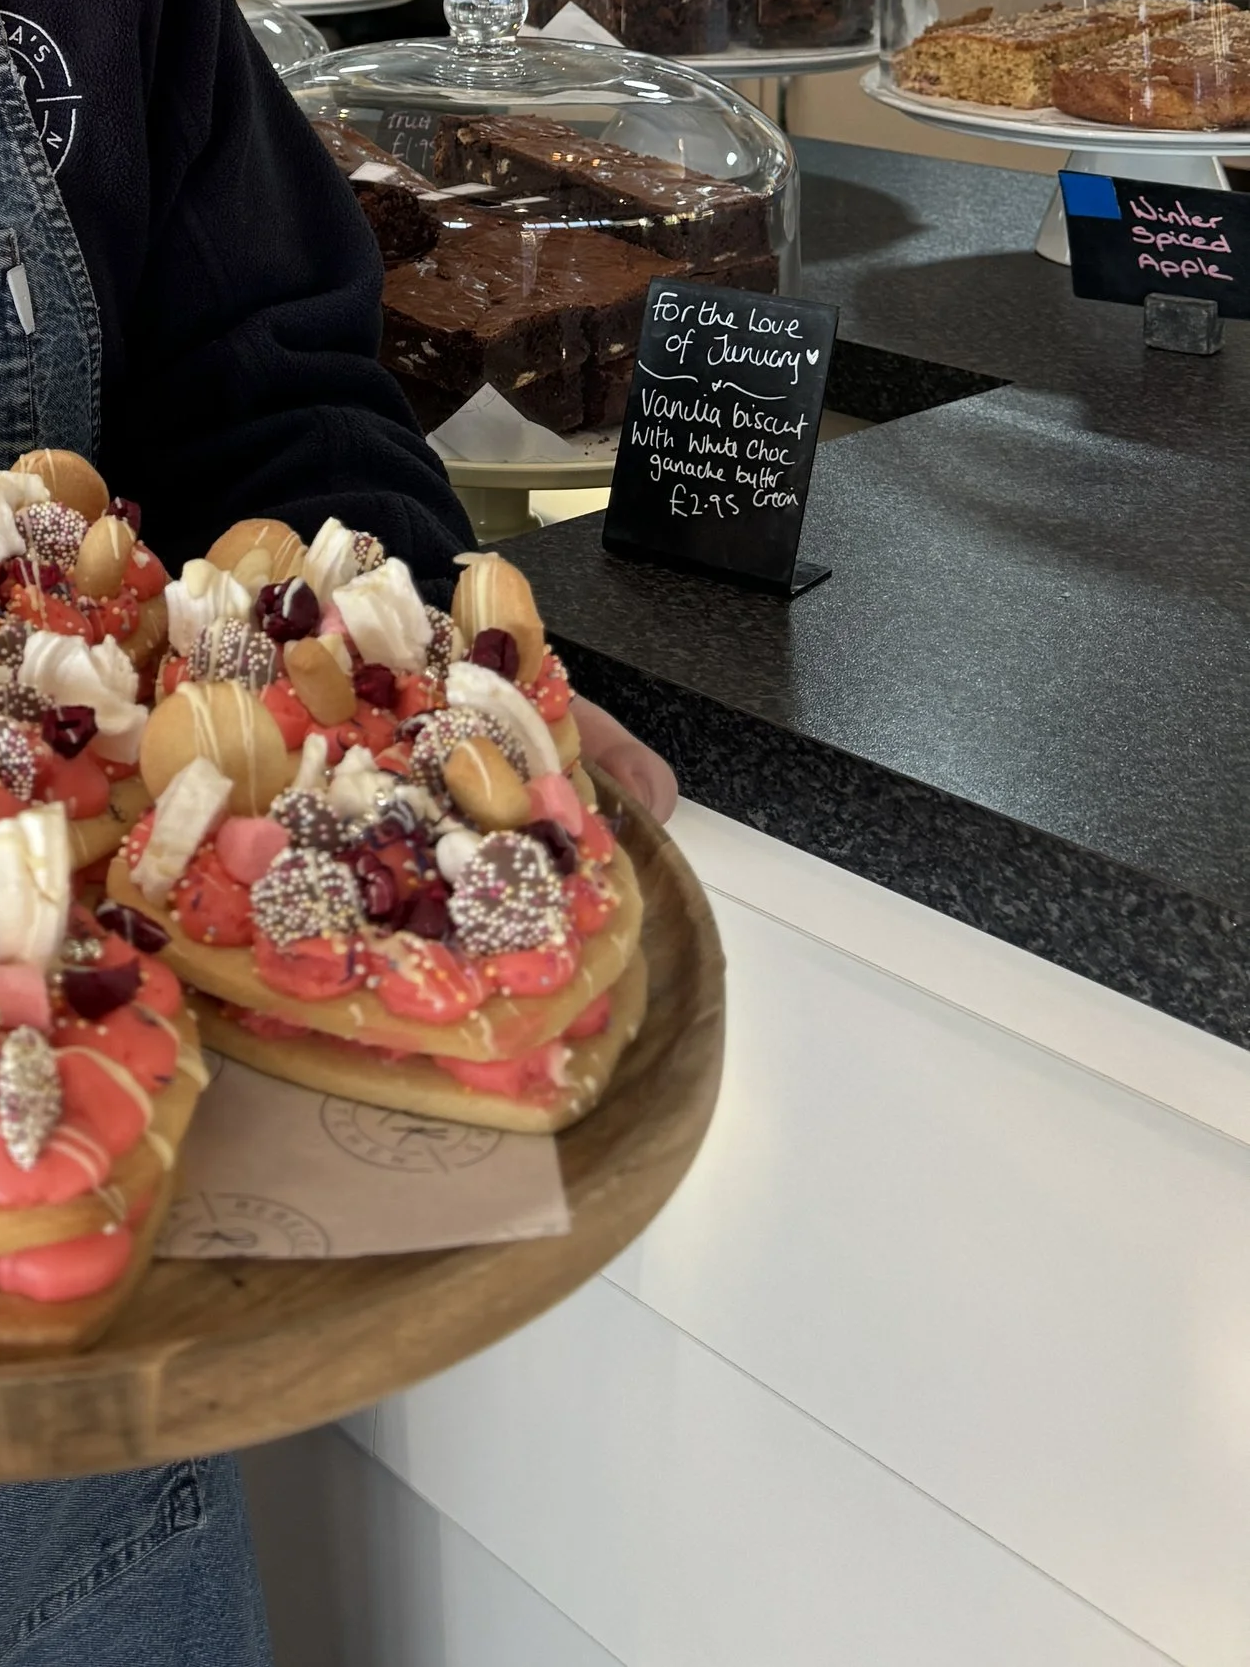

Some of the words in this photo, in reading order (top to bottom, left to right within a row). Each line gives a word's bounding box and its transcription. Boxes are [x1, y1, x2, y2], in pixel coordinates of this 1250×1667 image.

[1129, 195, 1224, 229] Winter
[1131, 225, 1233, 254] Spiced
[1137, 252, 1235, 282] Apple
[652, 291, 695, 322] For
[697, 300, 740, 330] the
[748, 308, 804, 340] Love
[664, 327, 697, 365] of
[732, 402, 810, 441] biscuit
[745, 438, 796, 466] Choc
[649, 453, 727, 483] ganache
[735, 464, 786, 489] butter
[669, 483, 740, 519] £2.95
